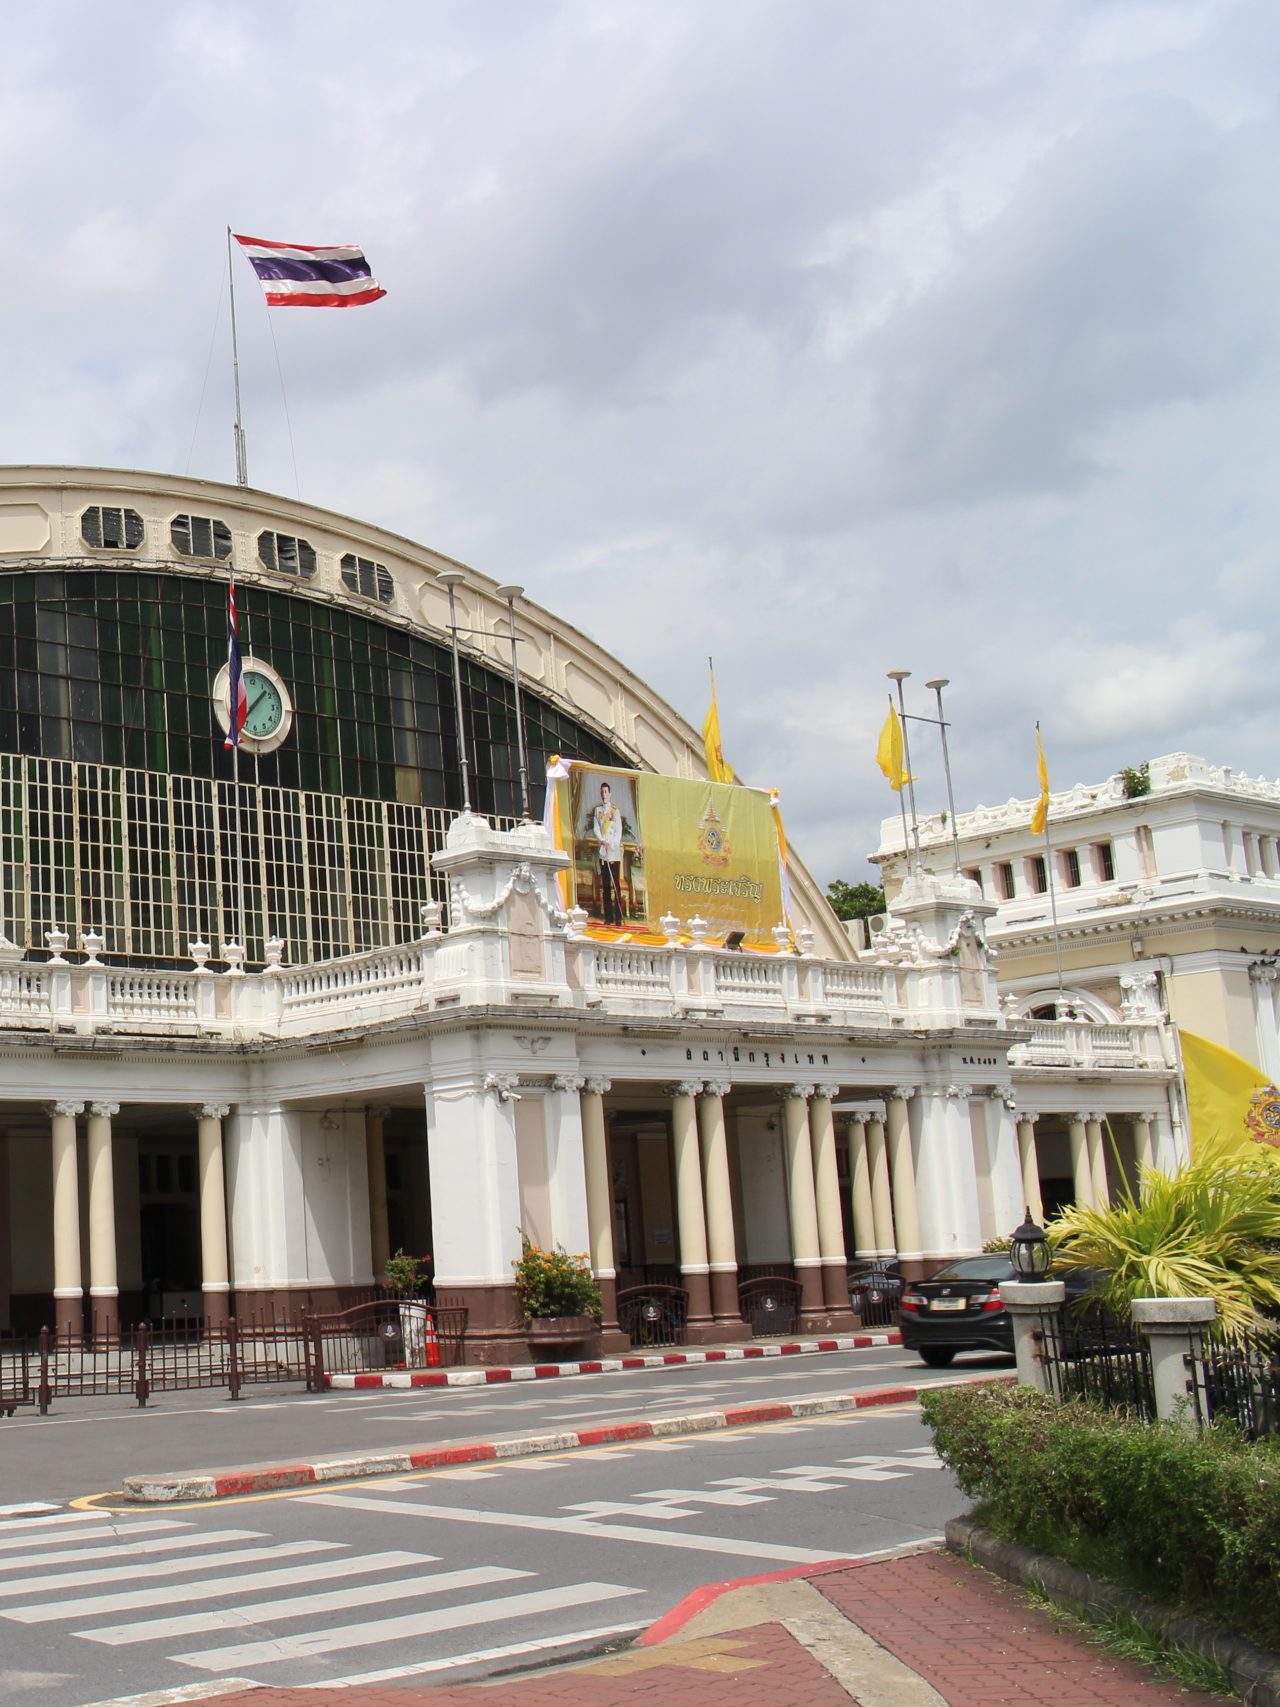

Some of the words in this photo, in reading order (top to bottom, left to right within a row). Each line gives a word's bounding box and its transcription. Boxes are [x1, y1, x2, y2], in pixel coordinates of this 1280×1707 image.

[674, 874, 763, 904] ทรงพระเจริญ
[686, 1046, 829, 1068] สถานีกรุงเทพ
